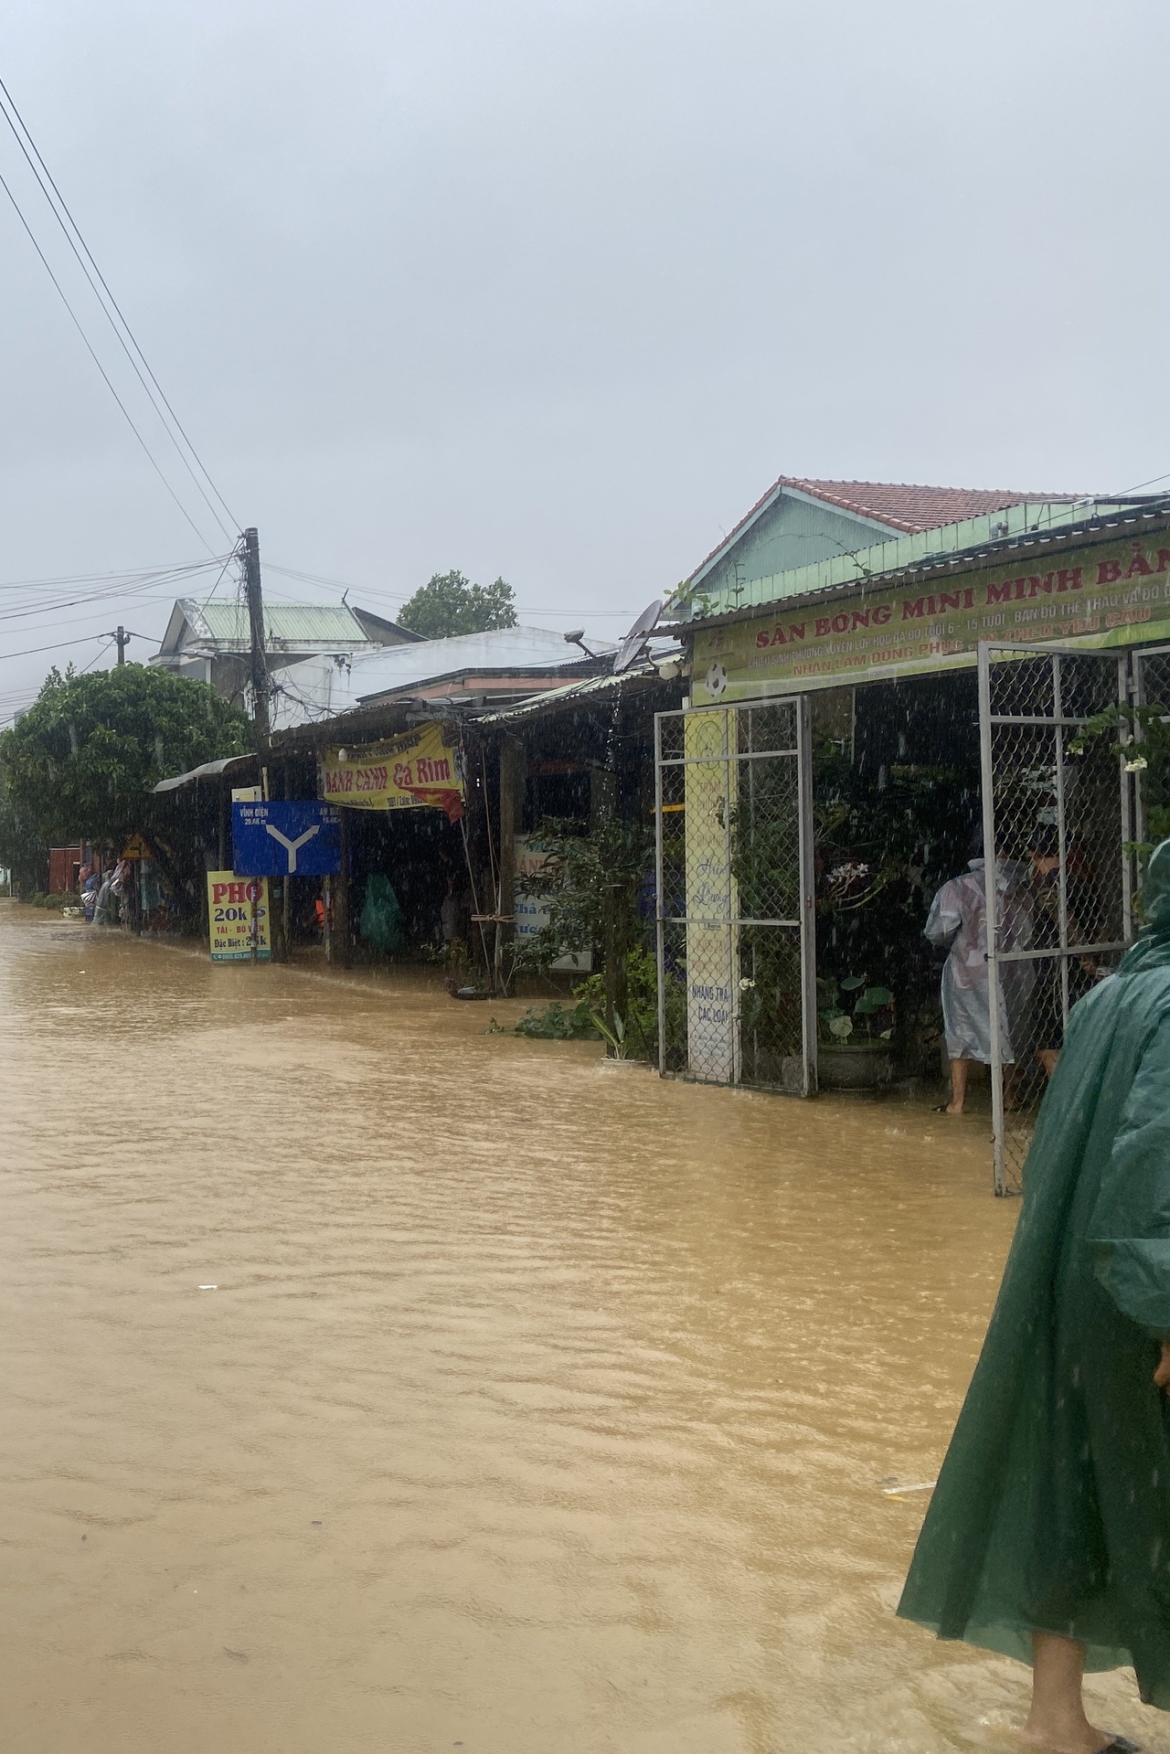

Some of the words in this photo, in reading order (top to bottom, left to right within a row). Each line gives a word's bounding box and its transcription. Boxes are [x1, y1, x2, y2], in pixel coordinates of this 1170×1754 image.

[755, 622, 807, 649] SÂN
[814, 605, 893, 638] BÓNG
[902, 587, 975, 620] MINI
[985, 566, 1084, 605] MINH
[355, 766, 388, 792] CANH
[214, 907, 247, 922] 20k
